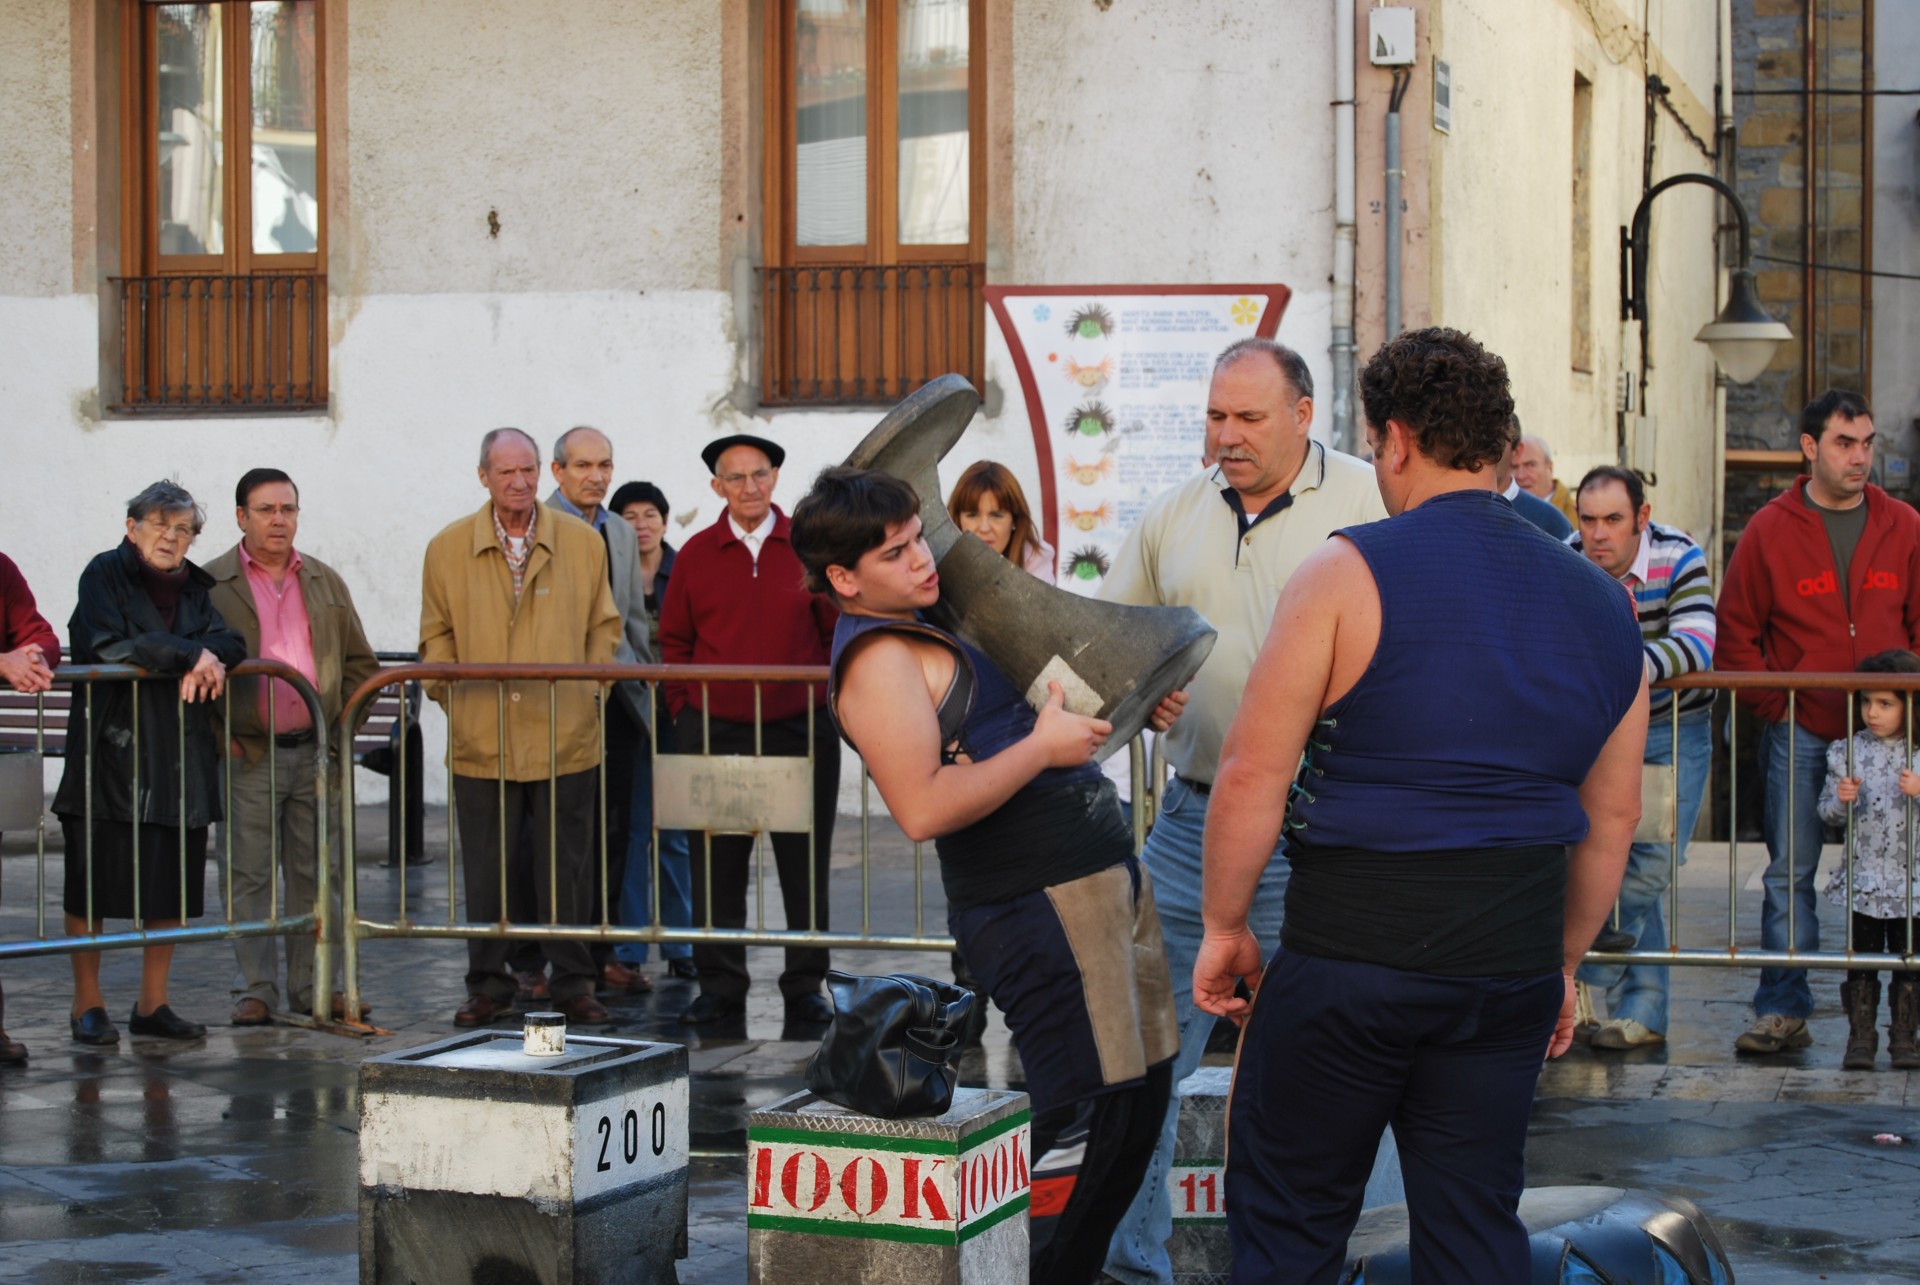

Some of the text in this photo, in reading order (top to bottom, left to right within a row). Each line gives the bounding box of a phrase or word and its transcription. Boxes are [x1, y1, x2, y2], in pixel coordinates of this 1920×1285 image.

[597, 1102, 665, 1173] 200
[750, 1147, 955, 1221] 100K
[957, 1129, 1030, 1224] 100K
[1179, 1173, 1227, 1212] 11
